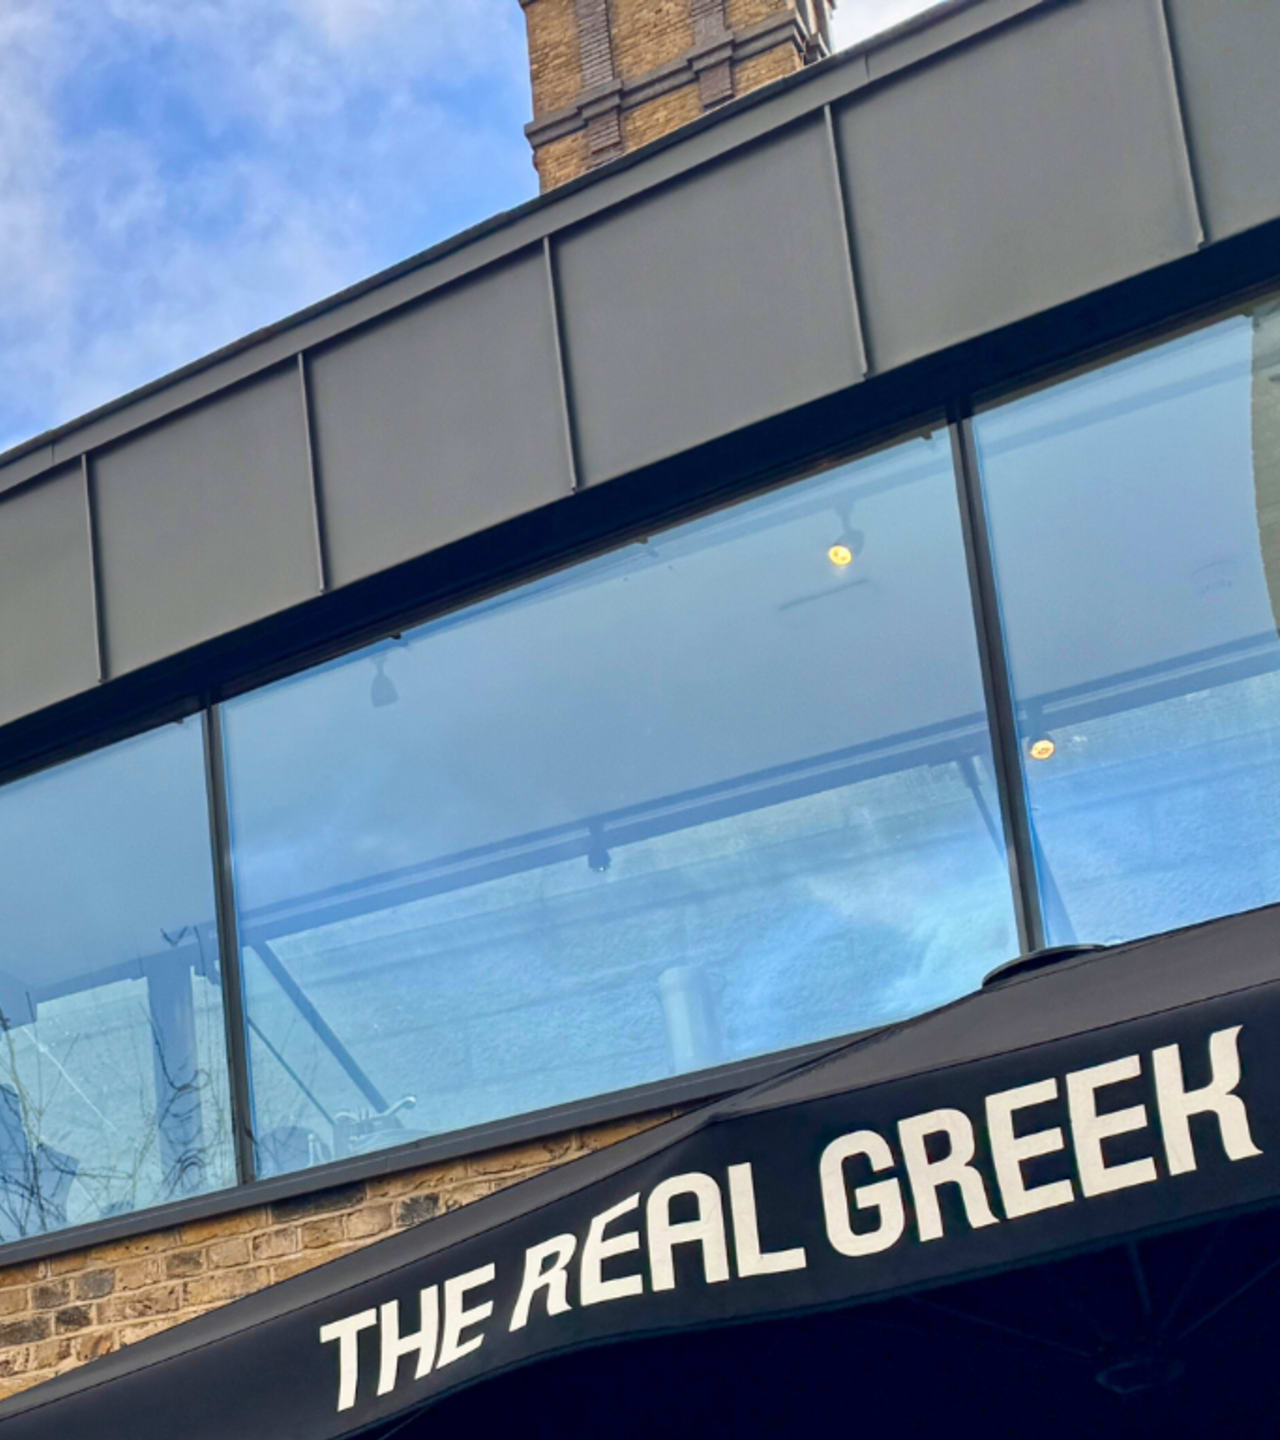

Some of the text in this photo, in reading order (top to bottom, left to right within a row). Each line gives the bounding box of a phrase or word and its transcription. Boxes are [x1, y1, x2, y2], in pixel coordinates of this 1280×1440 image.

[320, 1024, 1264, 1412] THE REAL GREEK
